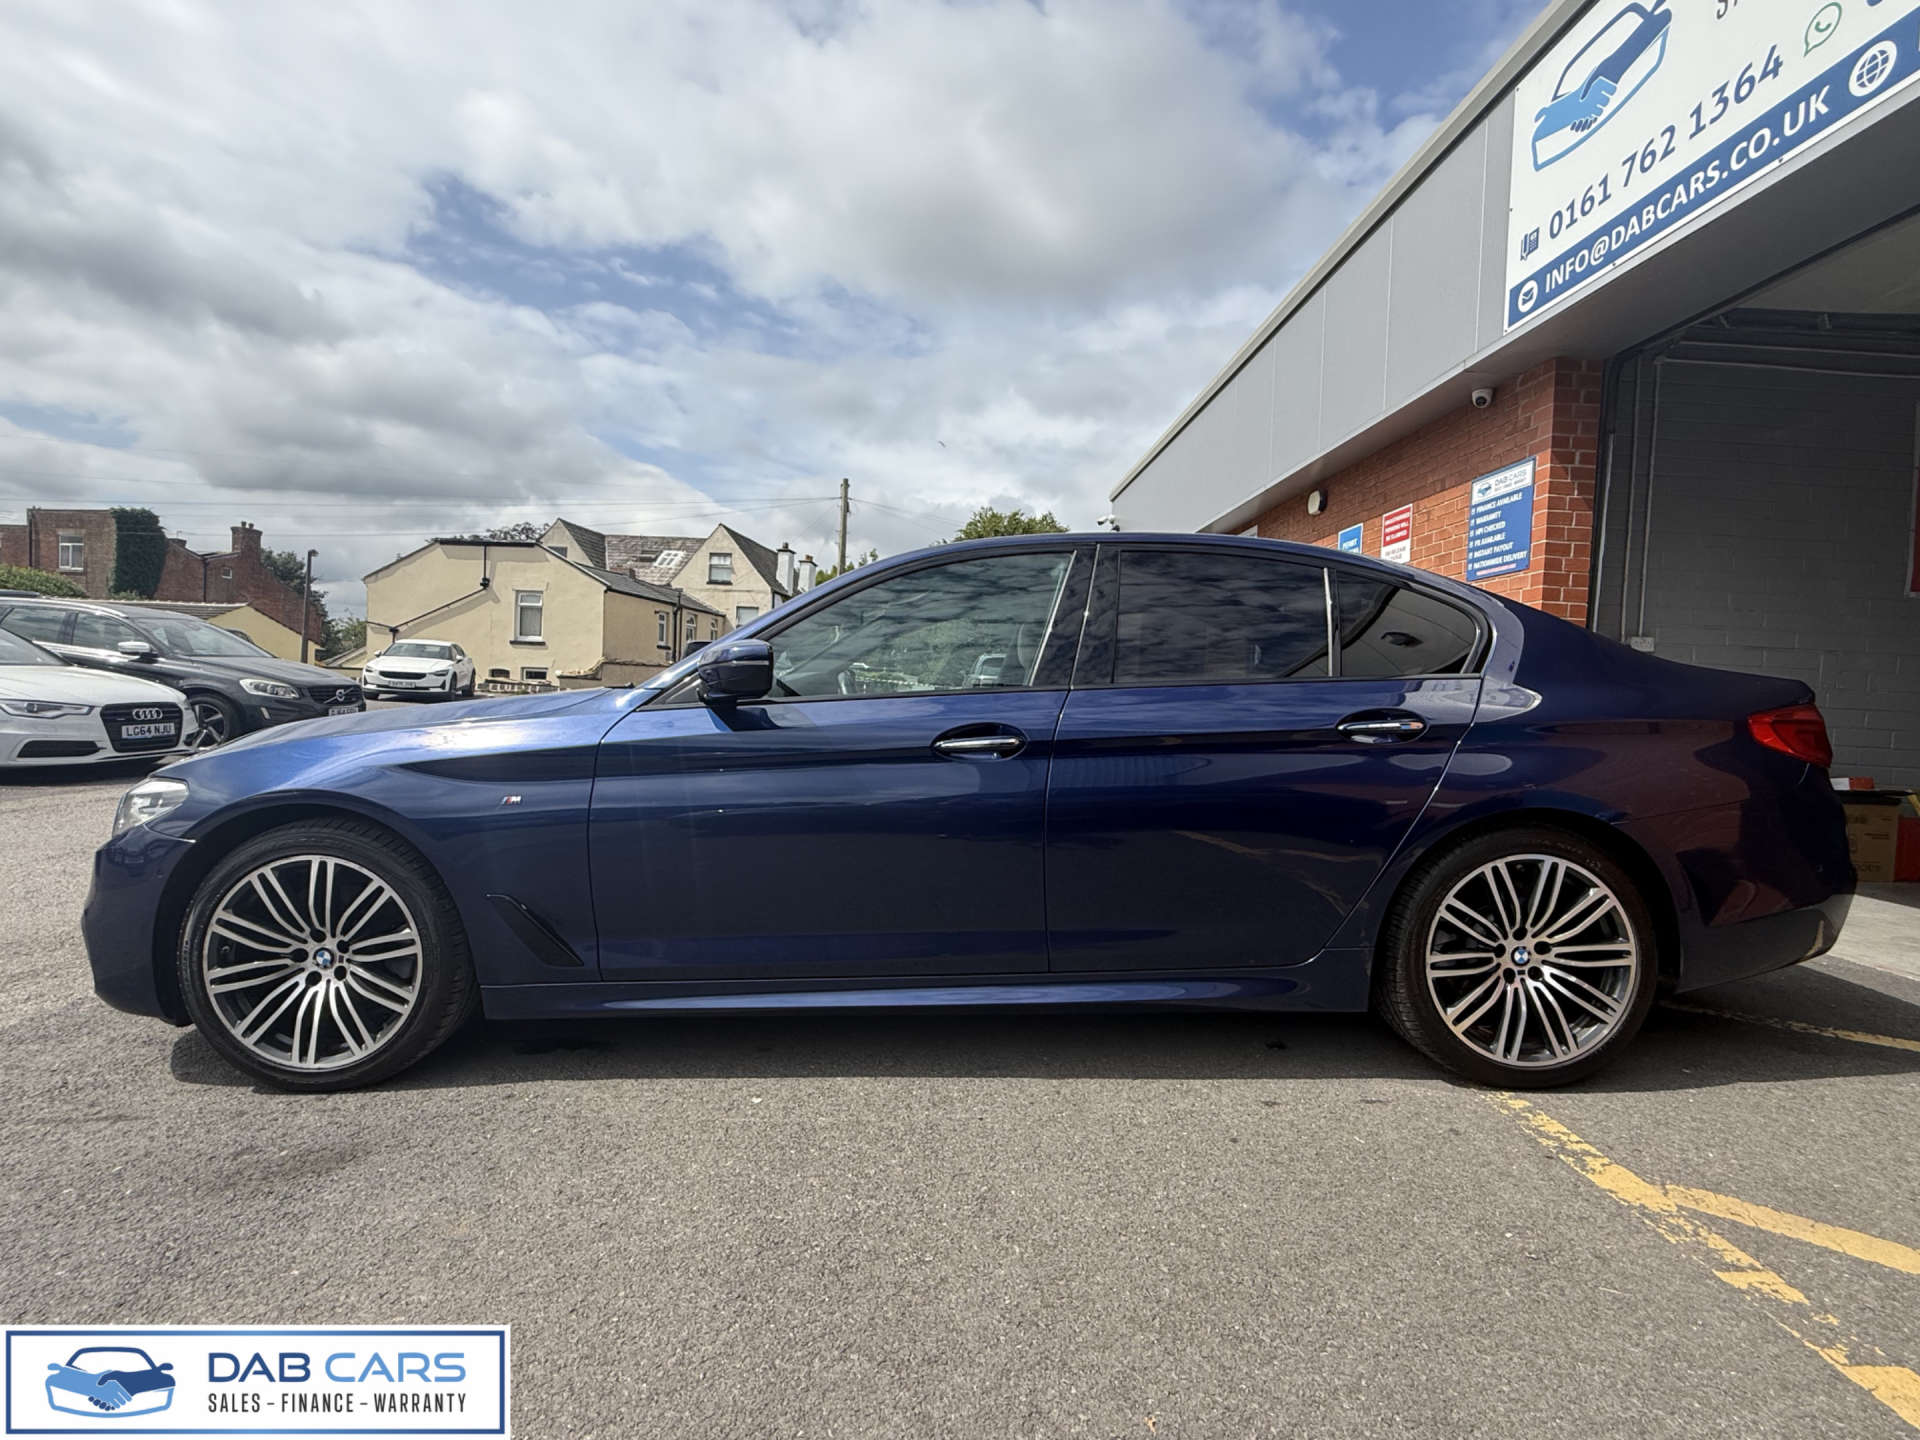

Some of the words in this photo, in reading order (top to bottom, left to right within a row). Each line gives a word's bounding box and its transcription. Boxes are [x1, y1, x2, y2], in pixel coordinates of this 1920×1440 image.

[1545, 86, 1830, 294] INFO@DABCARS.CO.UK
[1549, 173, 1612, 240] 0161
[1621, 125, 1676, 188] 762
[1688, 44, 1784, 141] 1364
[1497, 492, 1522, 505] AVAILABLE
[1503, 550, 1528, 563] DELIVERY
